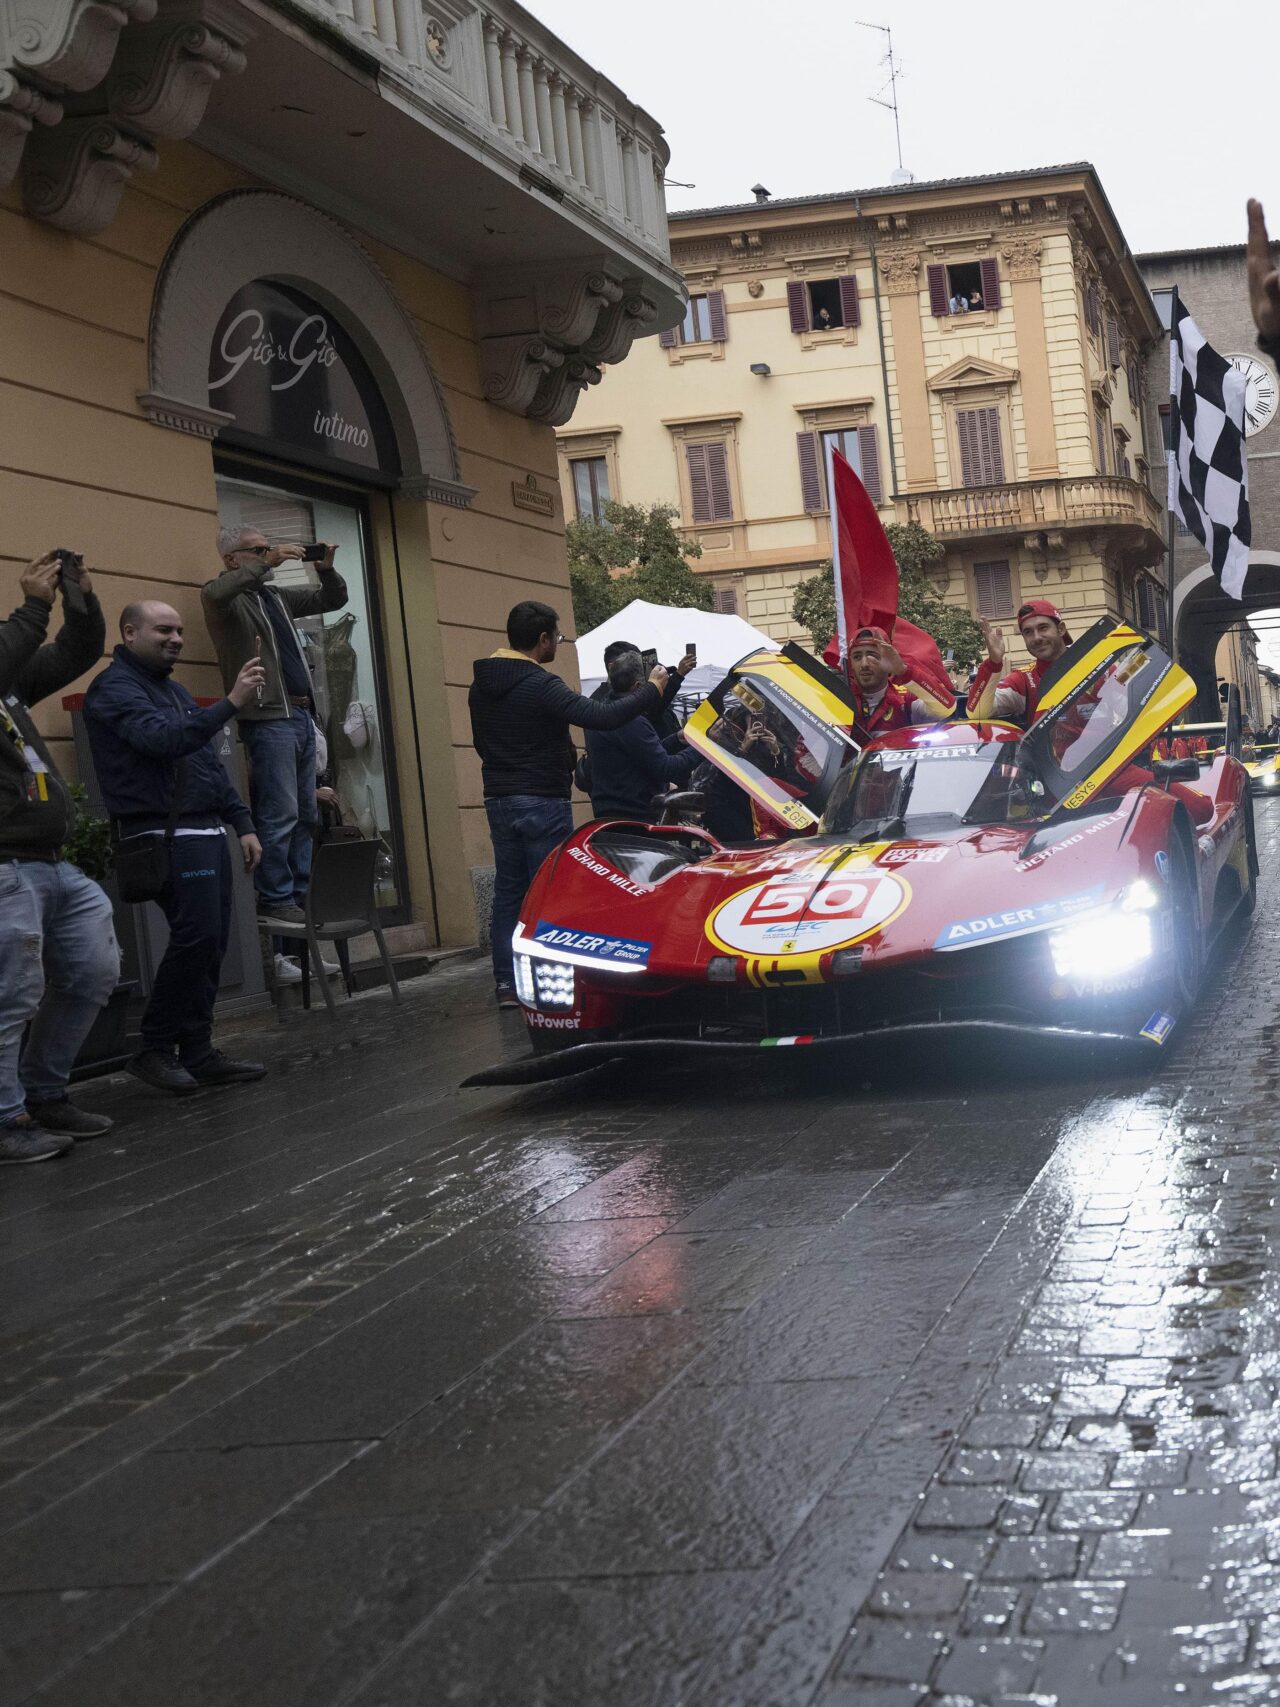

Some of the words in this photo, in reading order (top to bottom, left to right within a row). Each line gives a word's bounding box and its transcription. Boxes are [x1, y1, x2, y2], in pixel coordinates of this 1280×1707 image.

[278, 344, 289, 361] &
[313, 410, 369, 448] intimo
[868, 743, 980, 763] Ferrari
[567, 847, 610, 876] RICHARD
[606, 873, 647, 897] MILLE
[751, 882, 869, 919] 50
[948, 908, 1036, 939] ADLER
[535, 929, 605, 951] ADLER
[526, 1012, 581, 1029] V-Power
